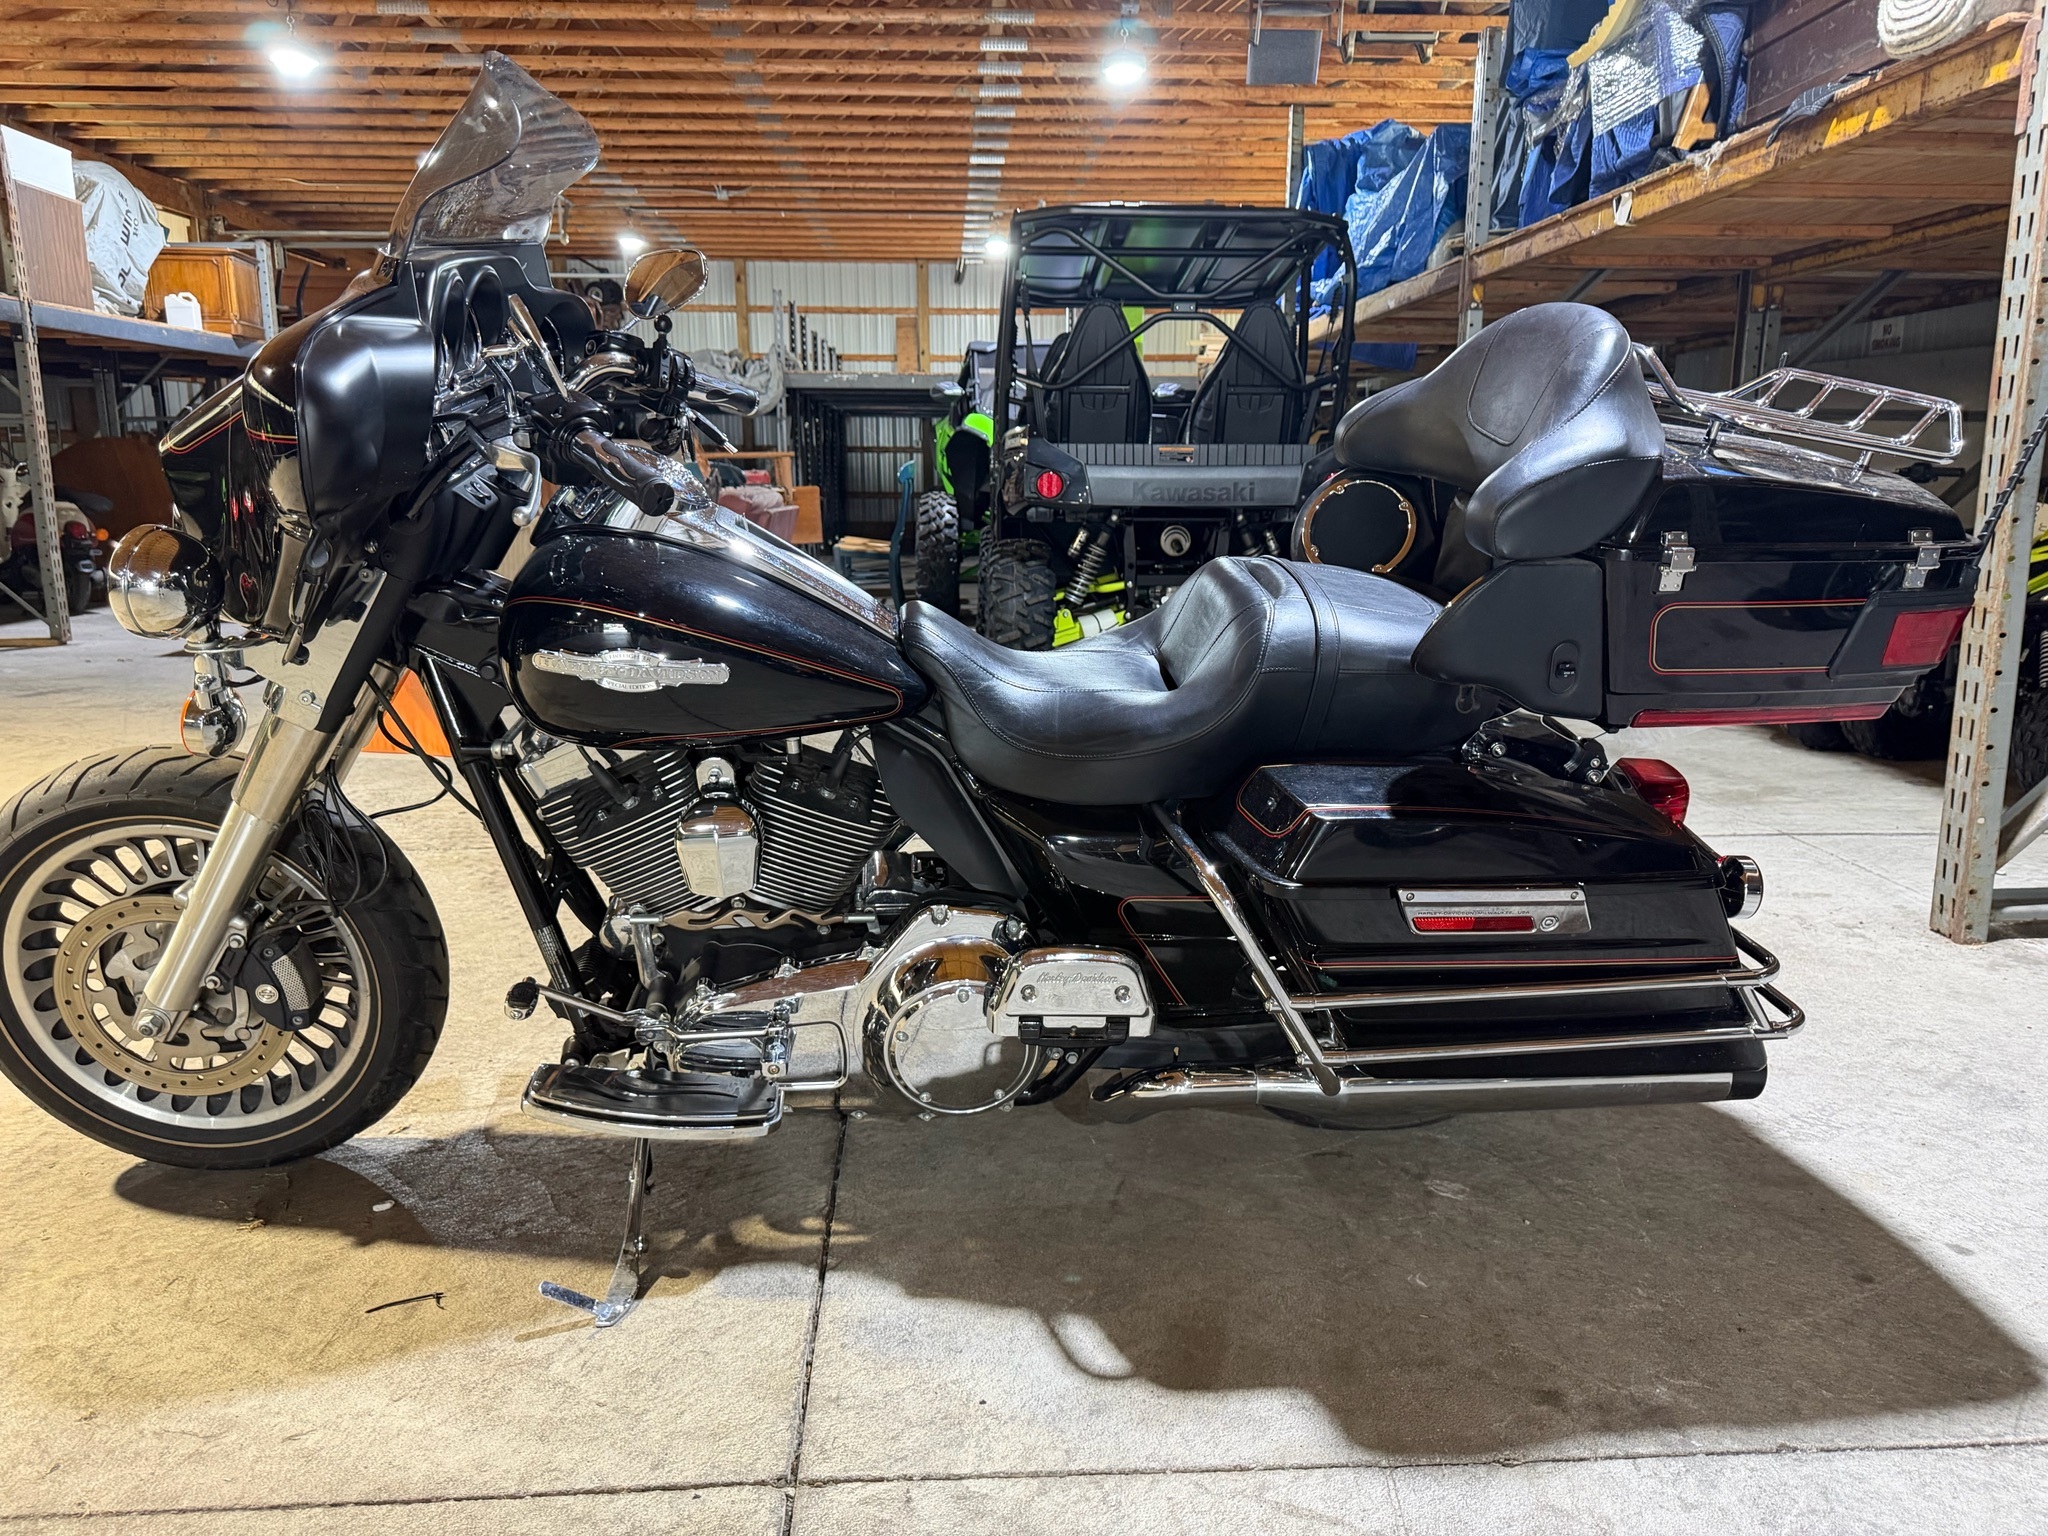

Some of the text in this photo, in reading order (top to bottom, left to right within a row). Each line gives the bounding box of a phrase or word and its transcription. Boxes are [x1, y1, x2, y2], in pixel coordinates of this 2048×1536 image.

[1883, 323, 1892, 336] NO
[1871, 336, 1901, 350] SMOKING
[1132, 481, 1255, 502] Kawasaki
[537, 655, 722, 681] HARLEY-DAVIDSON
[605, 680, 655, 690] SPECIAL EDITION
[1036, 972, 1119, 986] Harley-Davidson
